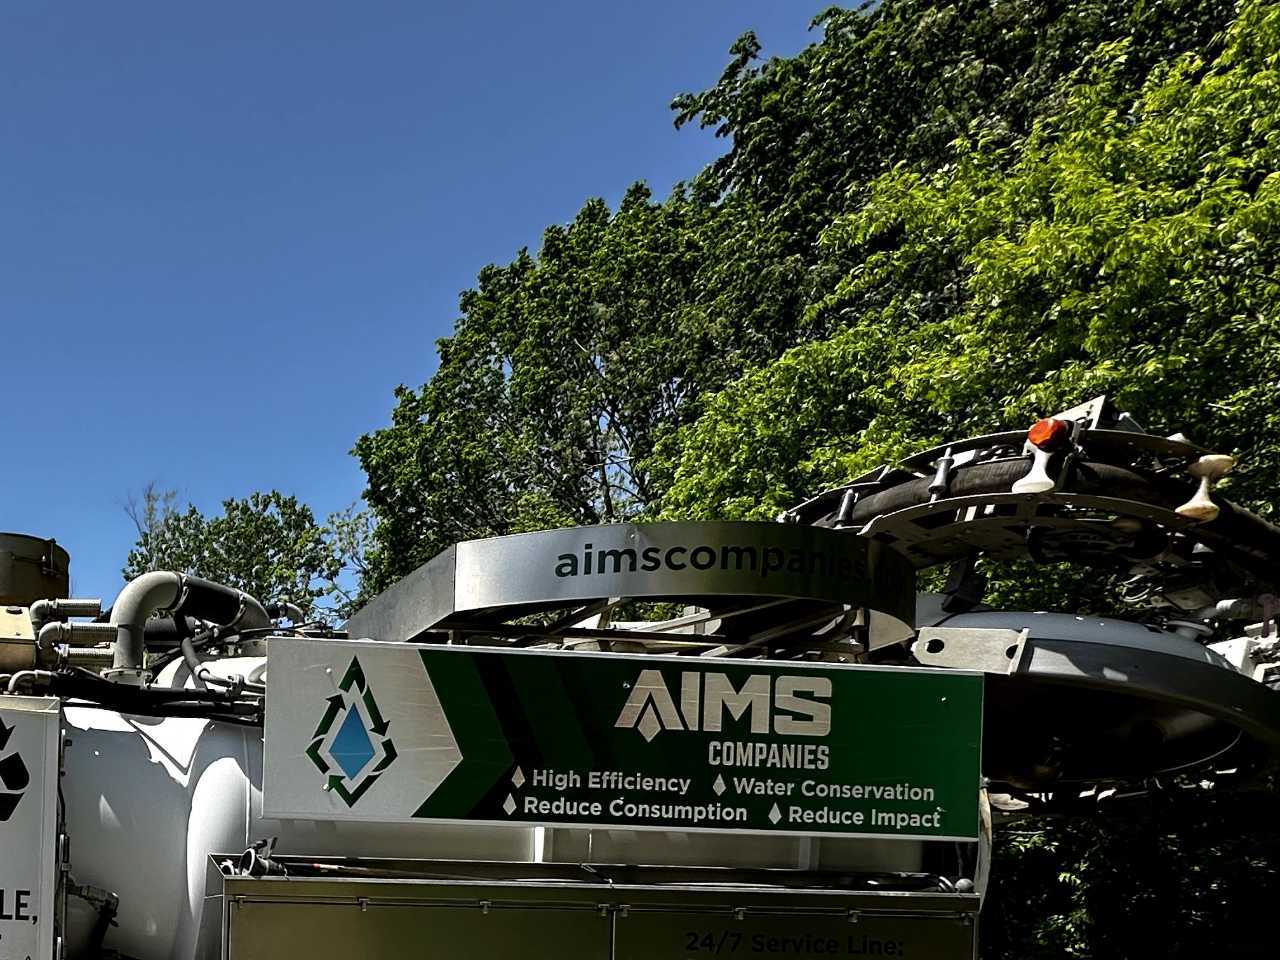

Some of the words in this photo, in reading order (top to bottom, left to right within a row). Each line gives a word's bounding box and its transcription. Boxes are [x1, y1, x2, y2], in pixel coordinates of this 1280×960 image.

[614, 669, 832, 738] AIMS
[708, 741, 829, 770] COMPANIES
[532, 769, 581, 791] High
[587, 771, 692, 796] Efficiency
[733, 777, 795, 796] Water
[801, 779, 935, 801] Conservation
[523, 796, 603, 816] Reduce
[609, 798, 748, 823] Consumption
[788, 806, 864, 825] Reduce
[871, 808, 942, 829] Impact
[685, 931, 744, 955] 24/7
[751, 933, 840, 954] Service
[847, 935, 905, 957] Line:
